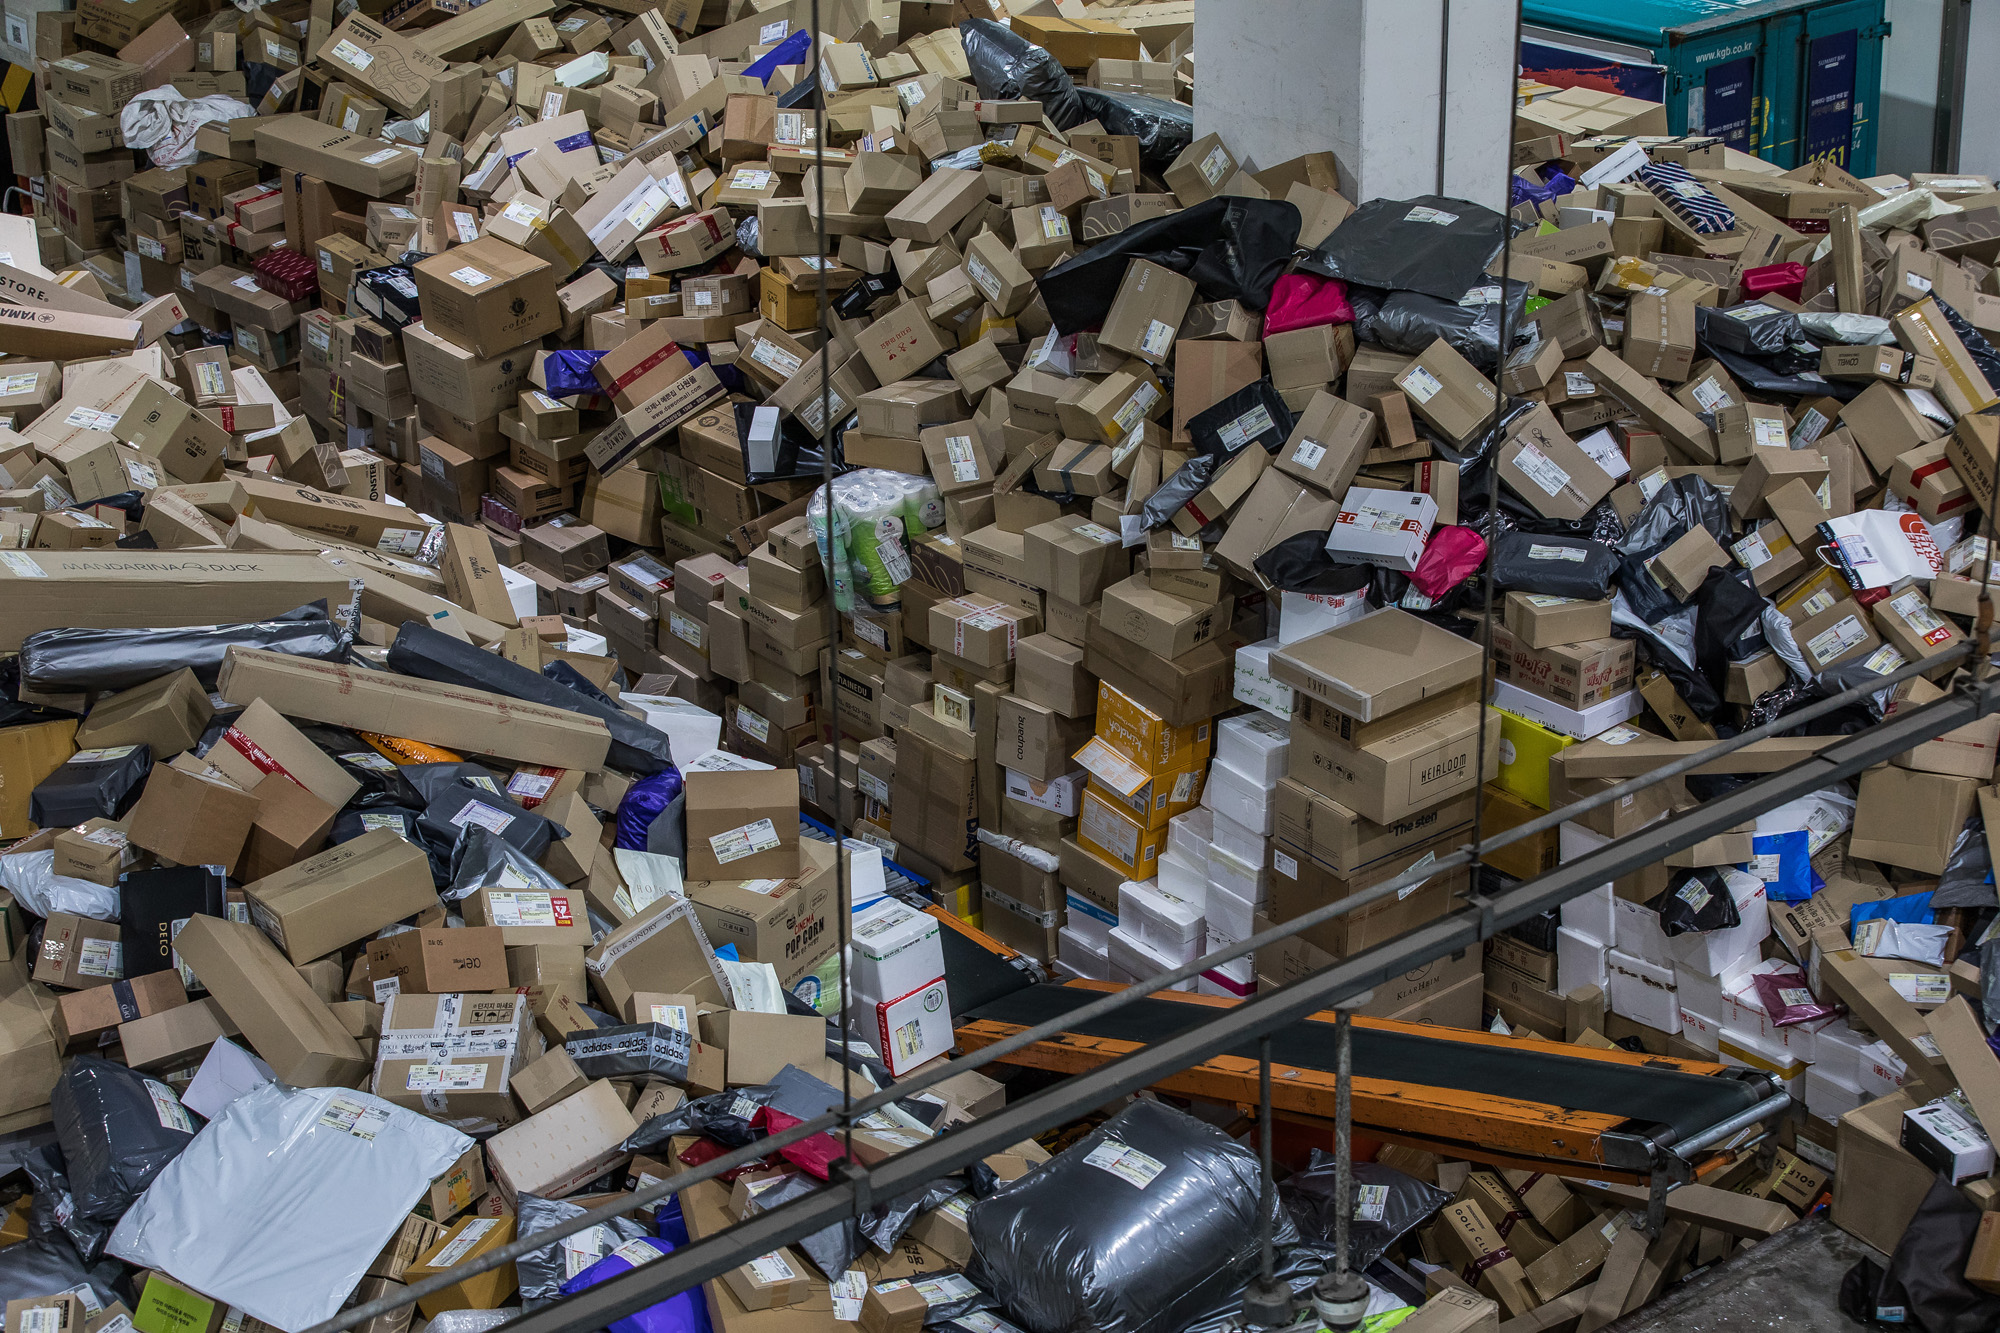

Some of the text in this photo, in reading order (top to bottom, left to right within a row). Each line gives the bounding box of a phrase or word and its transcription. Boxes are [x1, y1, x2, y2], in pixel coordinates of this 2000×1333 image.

[1696, 42, 1752, 63] www.kgb.co.kr
[1714, 84, 1733, 96] SUMMIT
[53, 118, 75, 141] TEMPUR
[322, 135, 351, 149] NERDY
[503, 312, 540, 332] cotone
[1838, 357, 1859, 366] COWELL
[645, 376, 698, 414] 언제나 예쁜집 다원몰
[651, 385, 703, 420] www.dawonmall.com
[607, 430, 628, 450] DAWON
[63, 562, 264, 573] MANDARINA DUCK
[1051, 608, 1073, 620] KINGS
[1108, 717, 1142, 751] kindoh
[1538, 719, 1556, 730] SOLID
[1569, 729, 1587, 740] SOLID
[1017, 715, 1026, 760] coupang
[1159, 726, 1170, 766] kindoh
[376, 736, 411, 760] InBody
[1421, 754, 1467, 784] HEIRLOOM
[1393, 821, 1414, 838] The
[1088, 886, 1119, 910] CA-M-03
[629, 922, 658, 946] SUNDRY
[723, 922, 744, 933] 가공식품
[794, 914, 815, 935] CINEMA
[786, 939, 802, 959] POP
[803, 916, 826, 945] CORN
[397, 1033, 439, 1042] SEXYCOOKIE
[582, 1042, 612, 1054] adidas
[655, 1044, 685, 1060] adidas
[1788, 1170, 1815, 1188] GOLF
[1480, 1174, 1518, 1211] GOLF CLU
[1455, 1208, 1493, 1255] GOLF CLU
